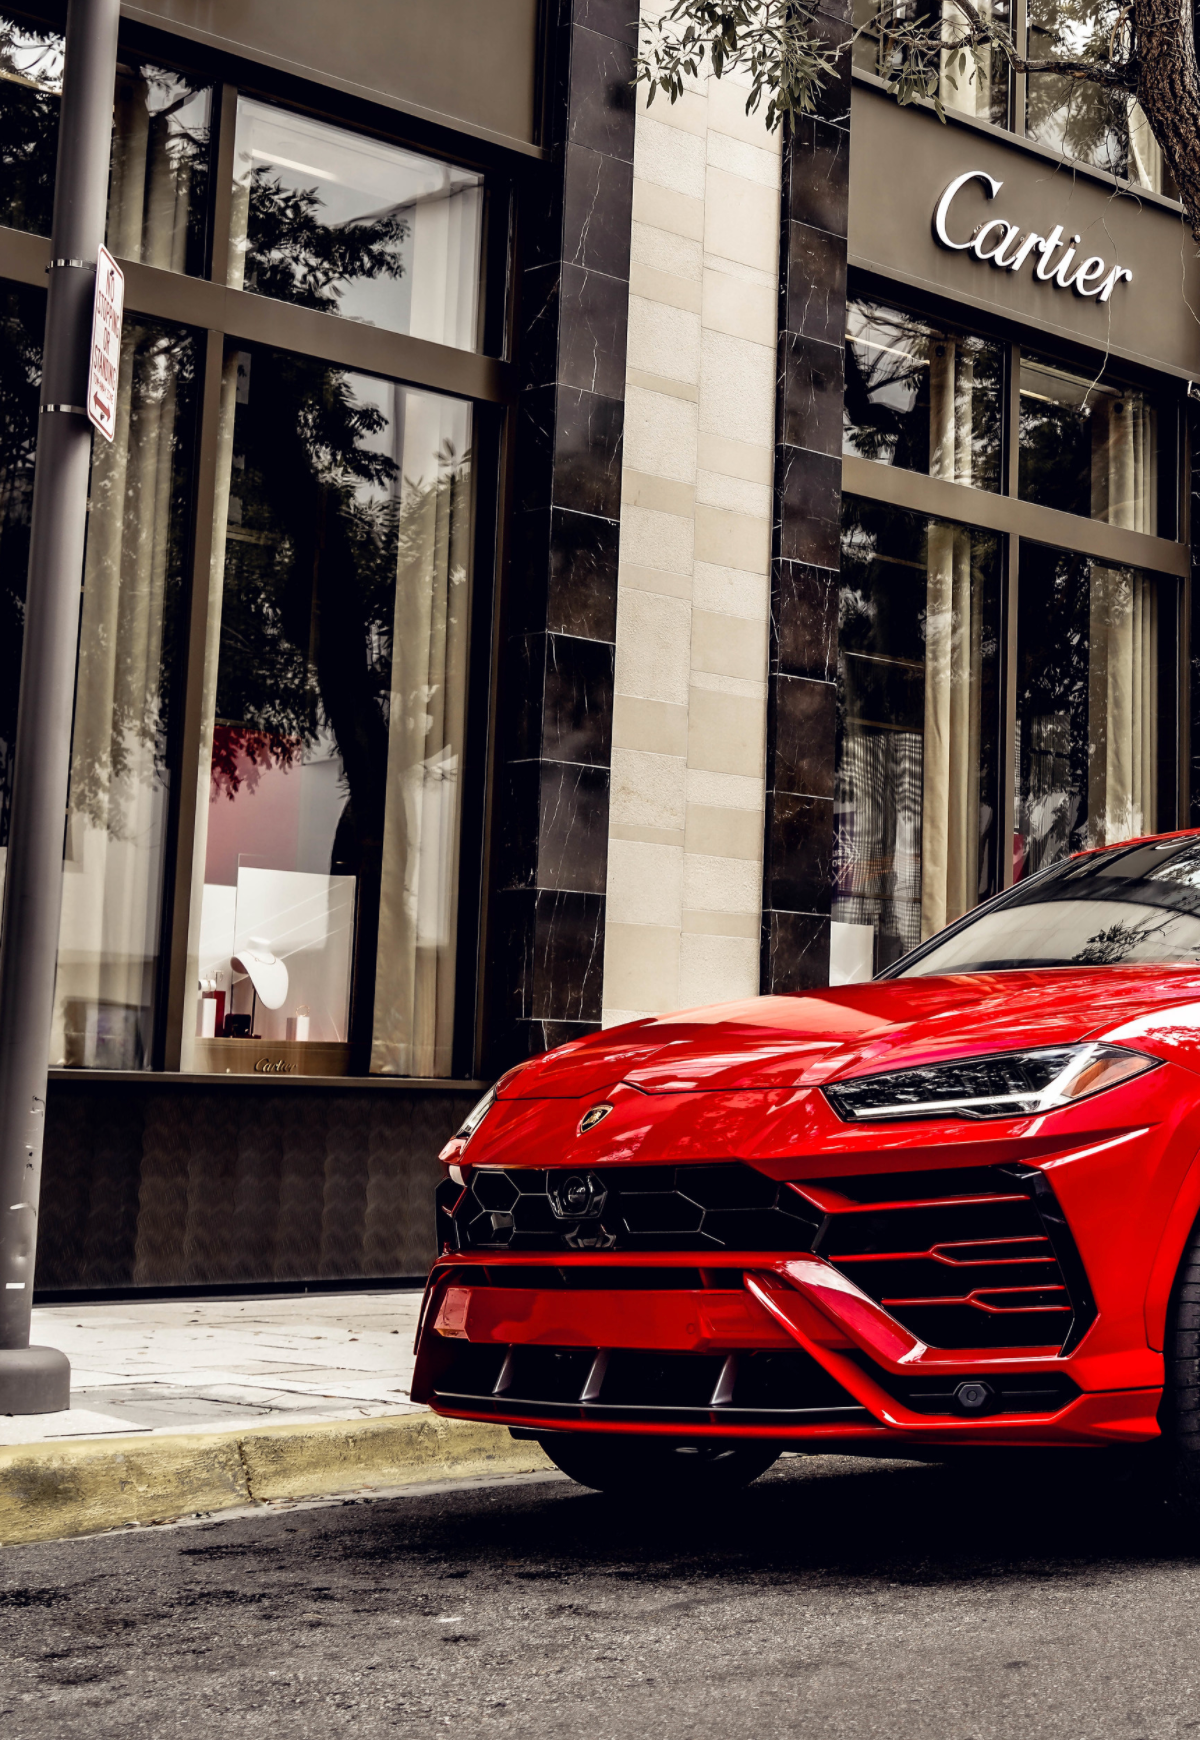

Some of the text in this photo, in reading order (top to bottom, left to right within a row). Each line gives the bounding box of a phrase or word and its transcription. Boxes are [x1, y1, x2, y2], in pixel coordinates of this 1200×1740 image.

[932, 170, 1132, 302] Cartier
[105, 269, 115, 303] NO
[96, 290, 120, 339] STOPPING
[103, 327, 111, 356] OR
[94, 344, 116, 391] STANDING
[254, 1057, 298, 1072] Cartier
